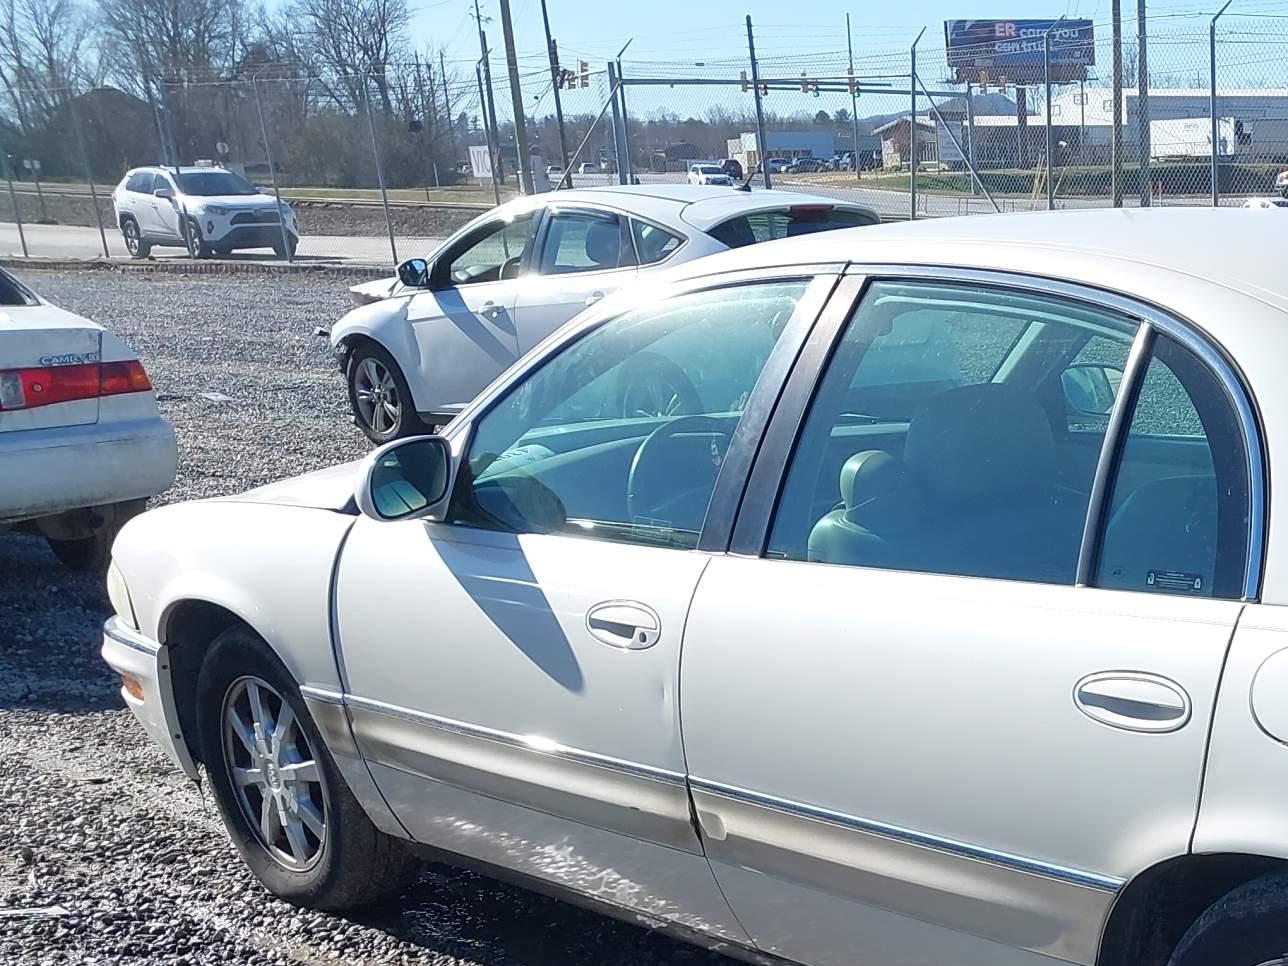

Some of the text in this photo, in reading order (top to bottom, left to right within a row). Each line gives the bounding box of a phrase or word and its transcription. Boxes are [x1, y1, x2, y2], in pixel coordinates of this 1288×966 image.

[995, 23, 1079, 41] ER car you
